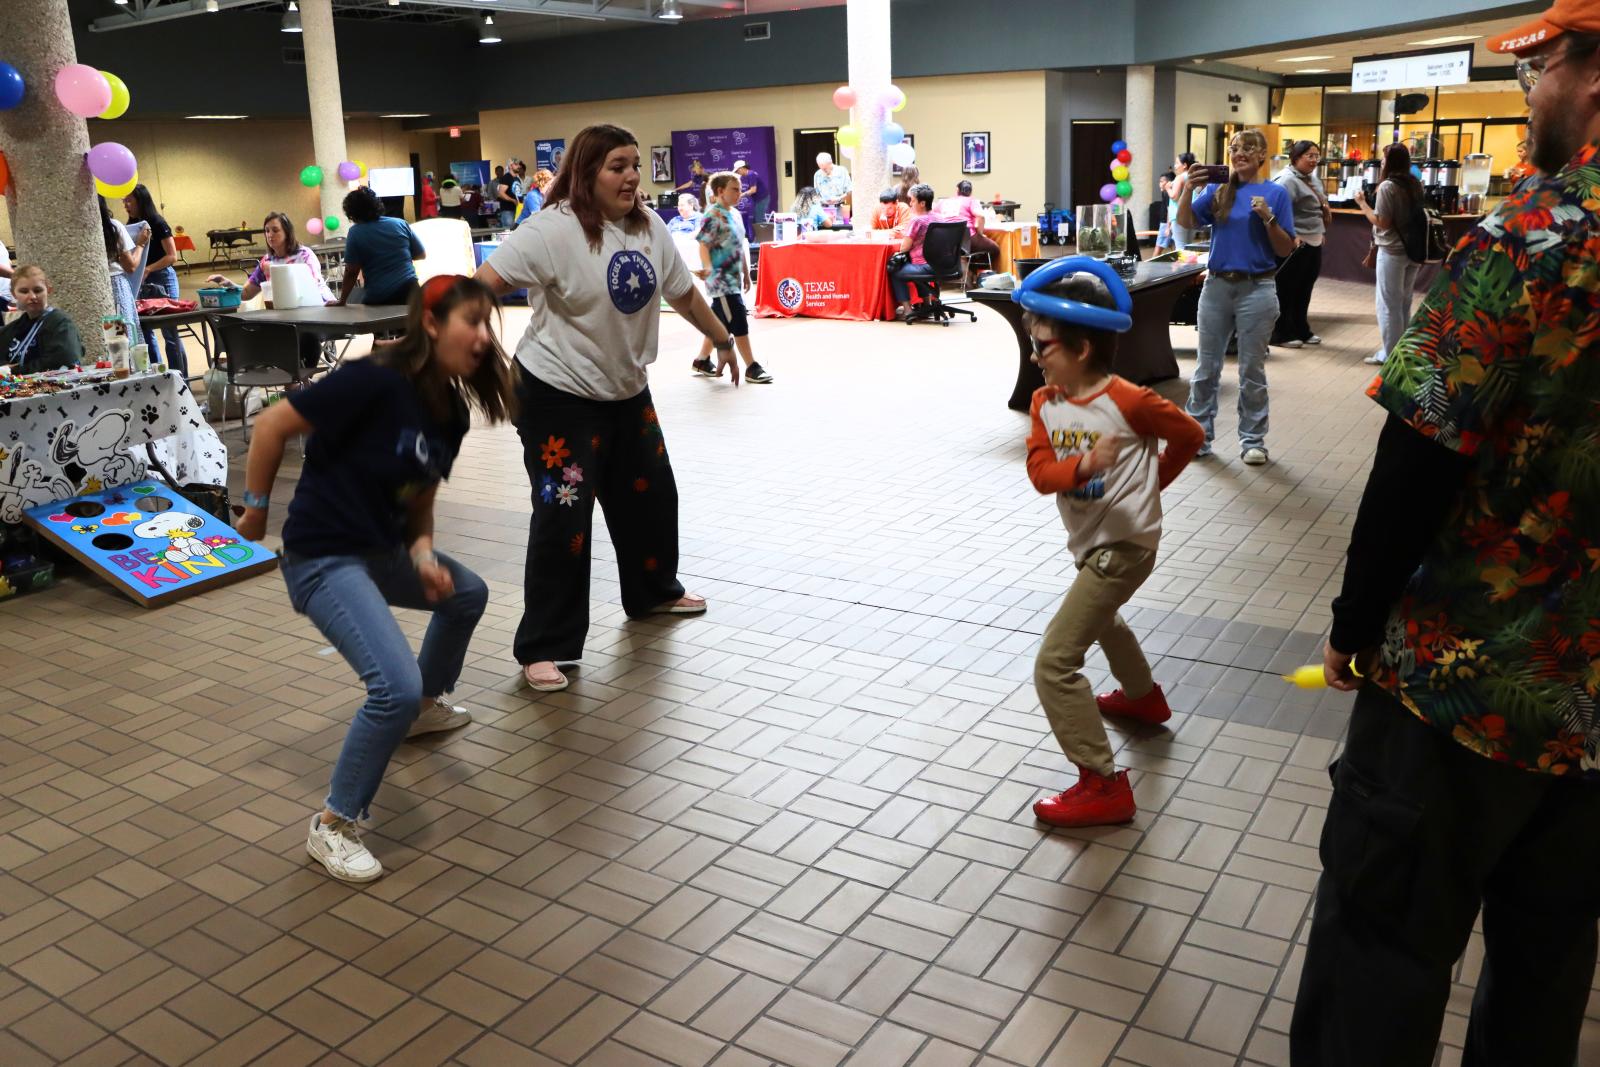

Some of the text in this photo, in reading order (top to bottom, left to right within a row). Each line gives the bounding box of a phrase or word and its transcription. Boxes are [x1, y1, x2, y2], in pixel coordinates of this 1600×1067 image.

[1500, 29, 1546, 50] TEXAS
[611, 262, 622, 290] FOCUS
[632, 254, 654, 285] THERAPY
[804, 281, 836, 292] TEXAS
[107, 547, 161, 571] BE
[130, 543, 254, 589] KIND
